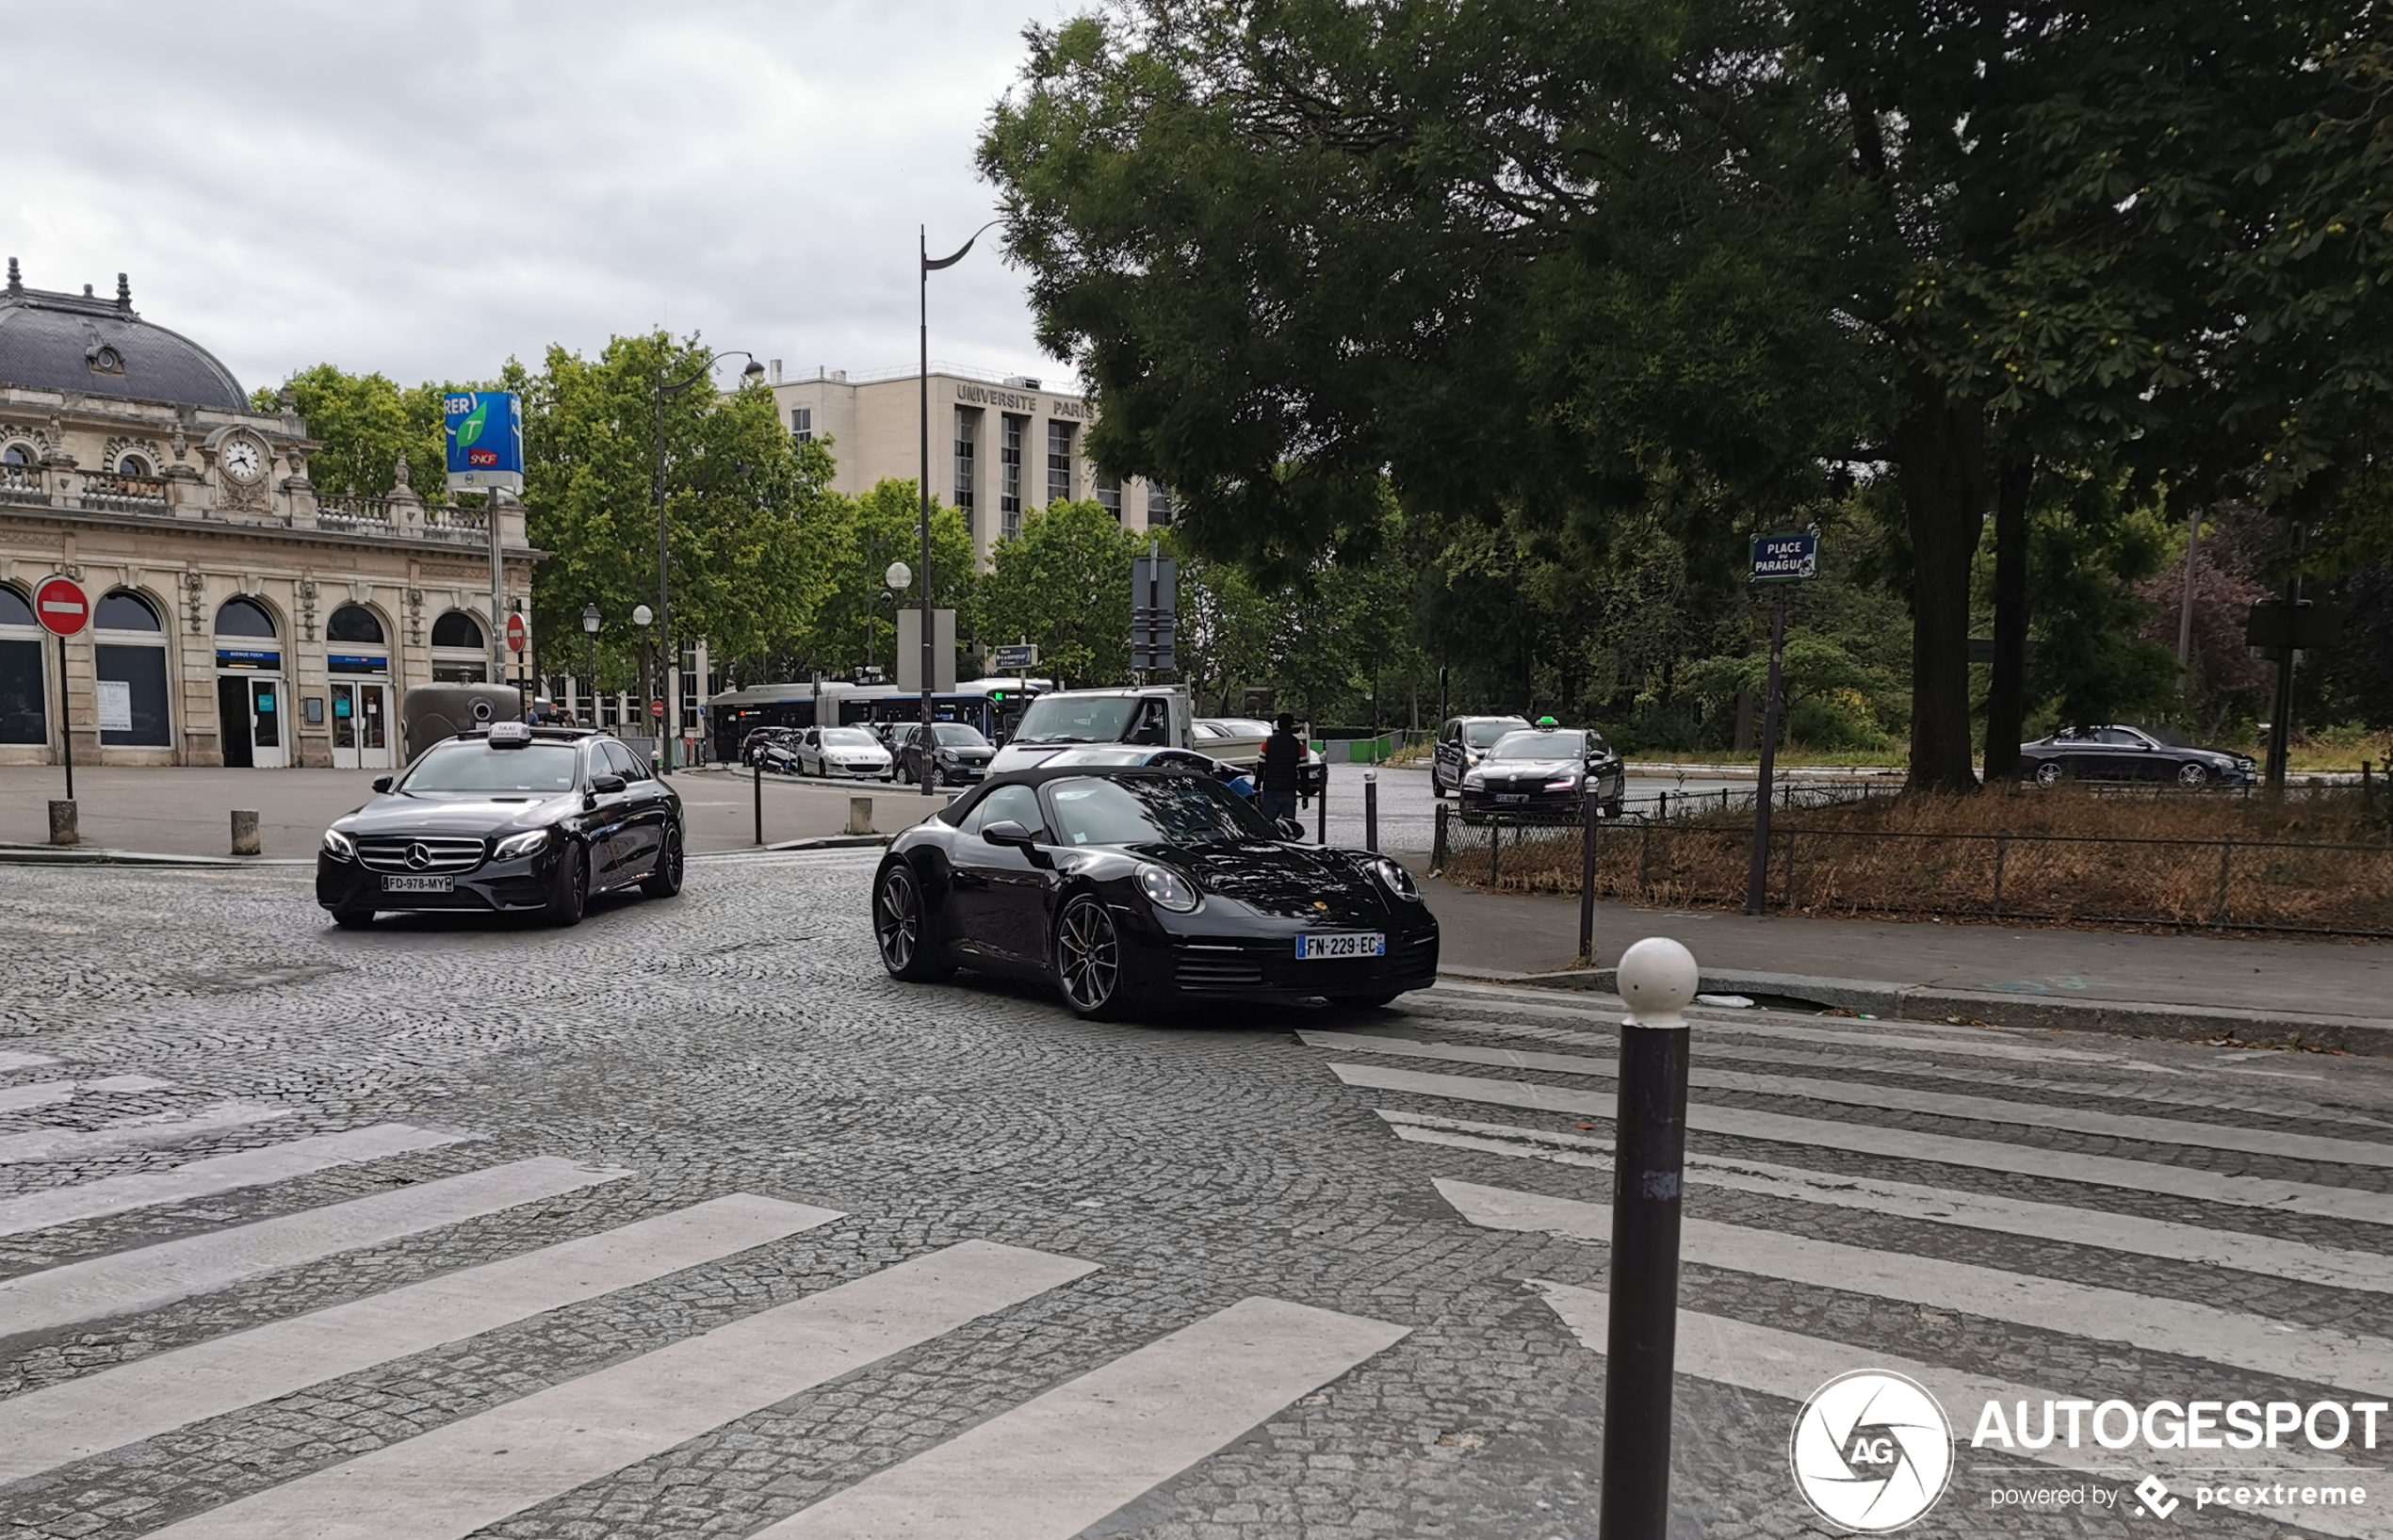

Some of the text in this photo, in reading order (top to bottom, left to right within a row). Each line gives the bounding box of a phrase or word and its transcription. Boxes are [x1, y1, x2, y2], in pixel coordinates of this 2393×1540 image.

[444, 397, 470, 414] RER
[957, 383, 1095, 419] UNIVERSITE PARIS
[466, 420, 482, 440] T
[469, 454, 496, 464] SNCF
[1767, 542, 1801, 555] PLACE
[389, 878, 444, 889] FD-978-MY
[1307, 936, 1376, 955] FN-229-EC
